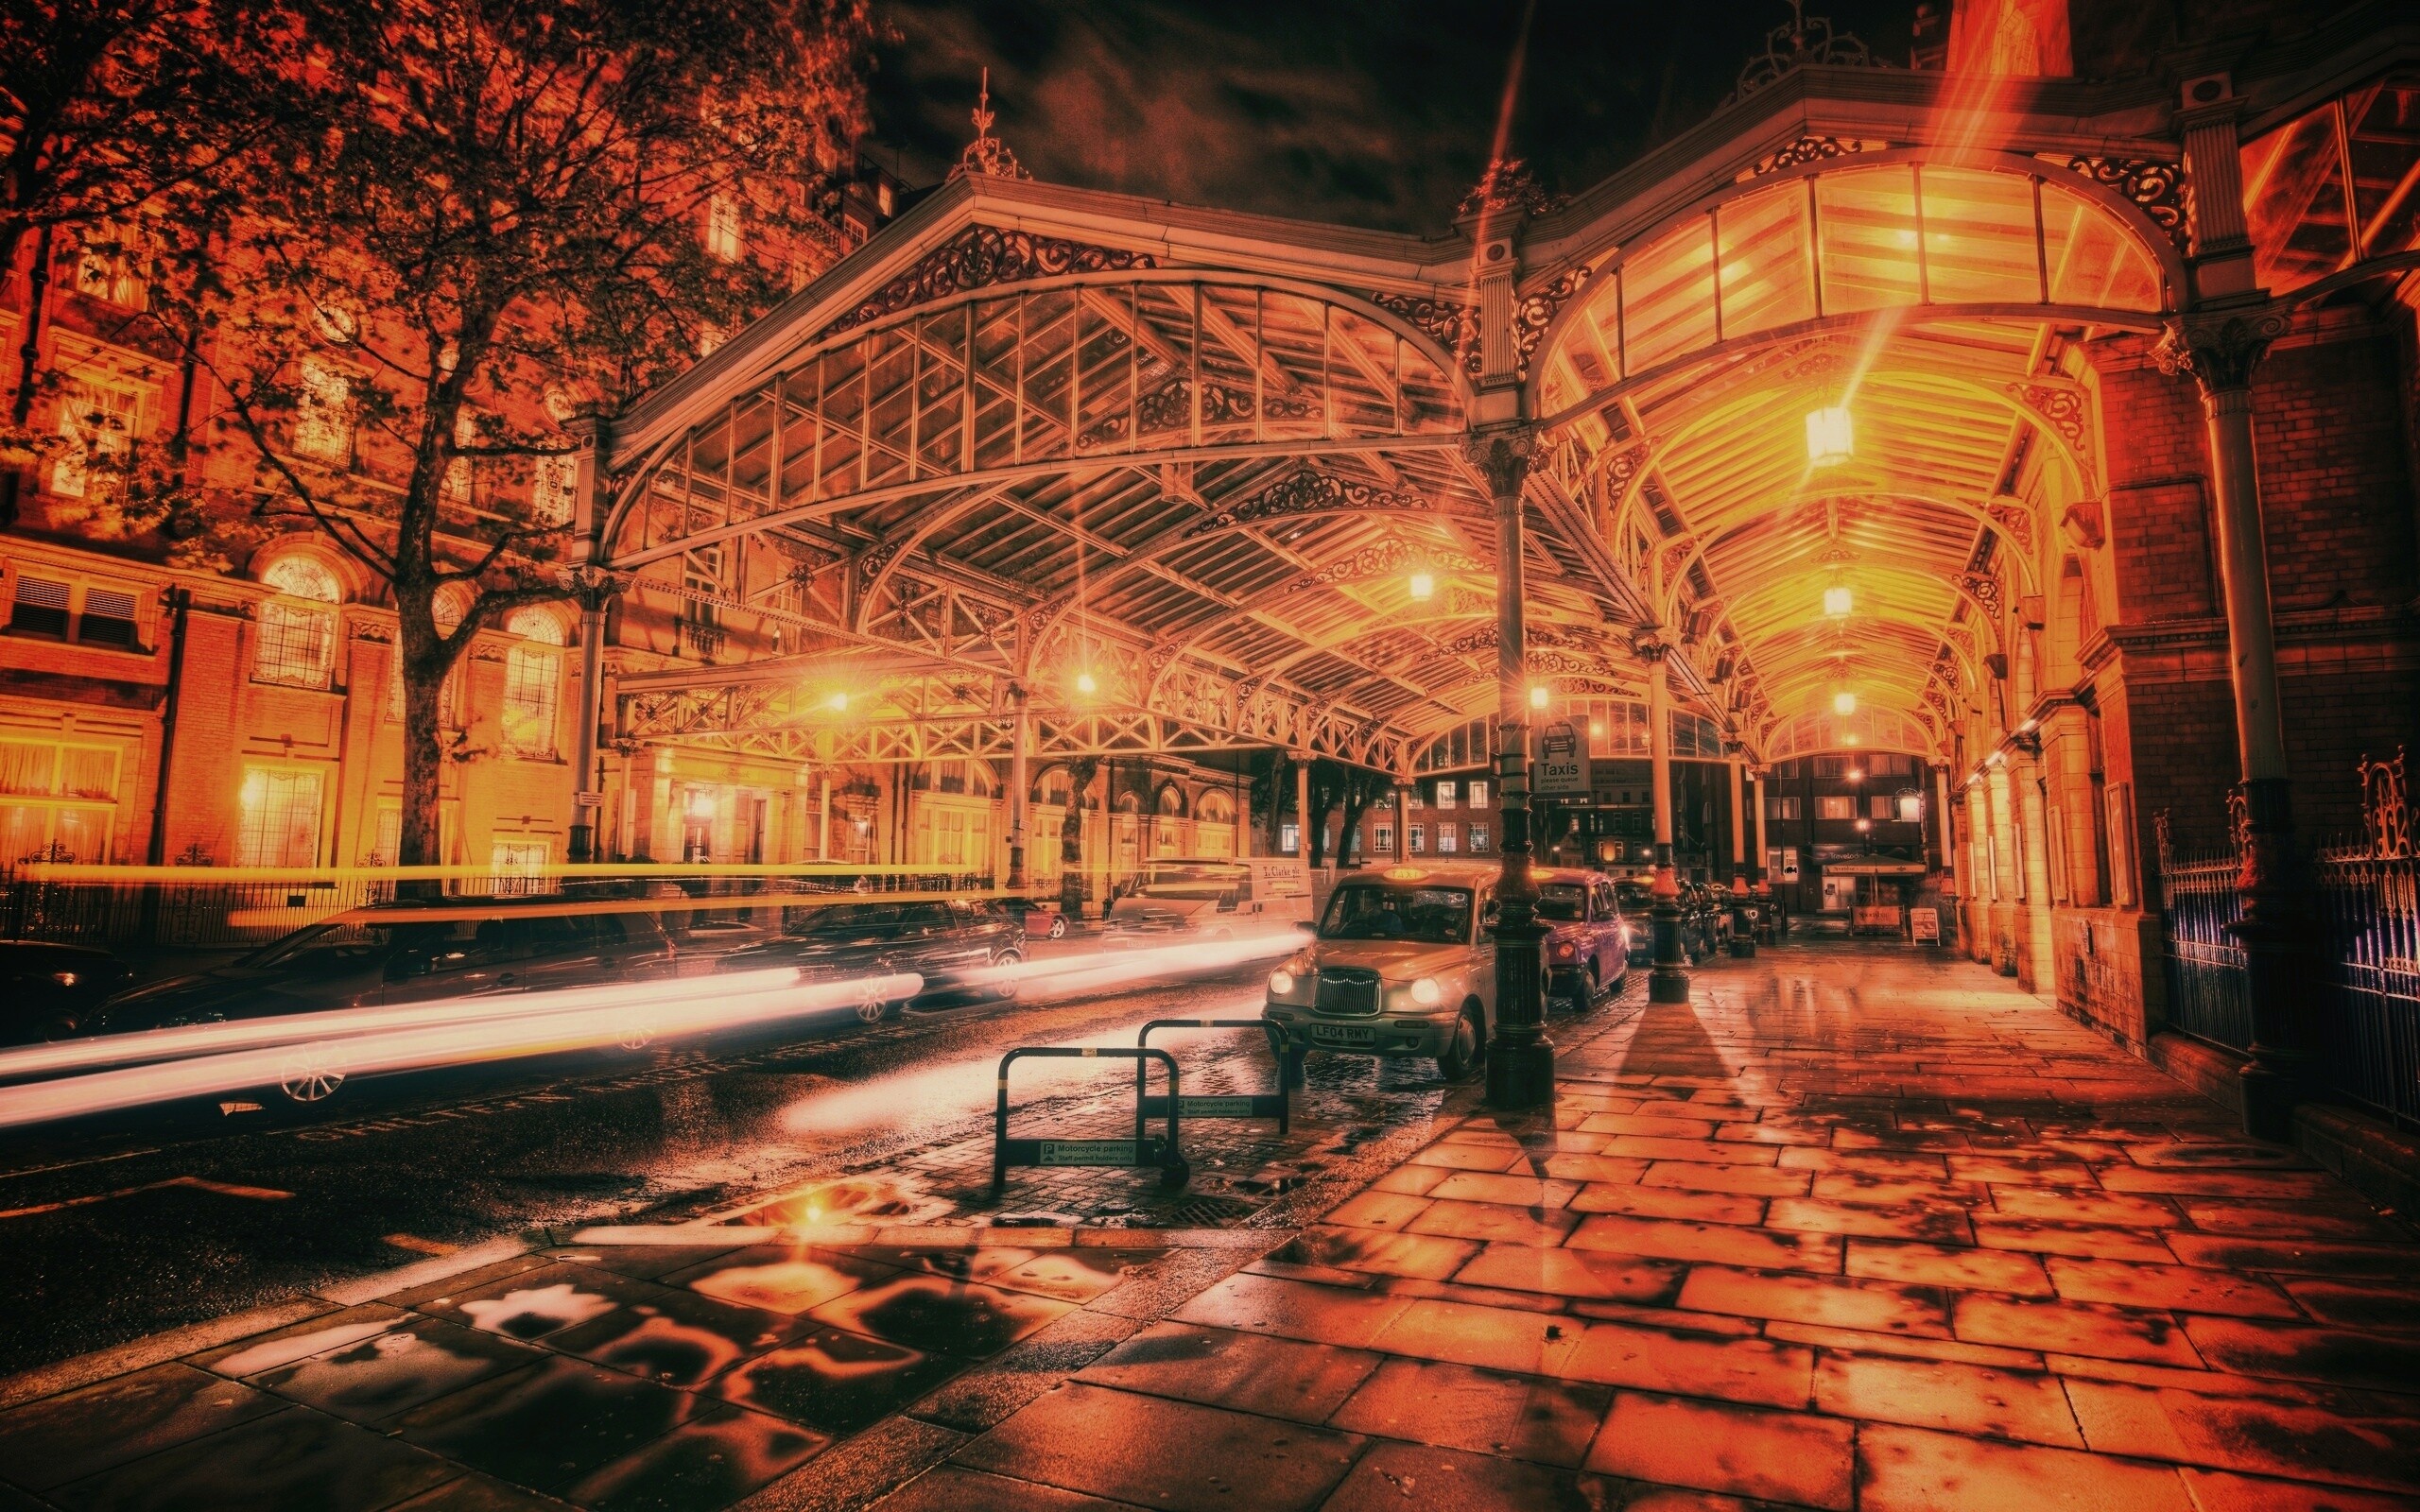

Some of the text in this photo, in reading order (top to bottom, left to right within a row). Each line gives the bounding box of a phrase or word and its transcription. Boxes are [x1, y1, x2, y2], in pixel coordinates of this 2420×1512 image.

[1541, 763, 1579, 776] Taxis
[1392, 870, 1418, 879] TAXI
[1316, 1025, 1369, 1040] LF04 RMY
[1058, 1144, 1133, 1153] Motorcycle parking
